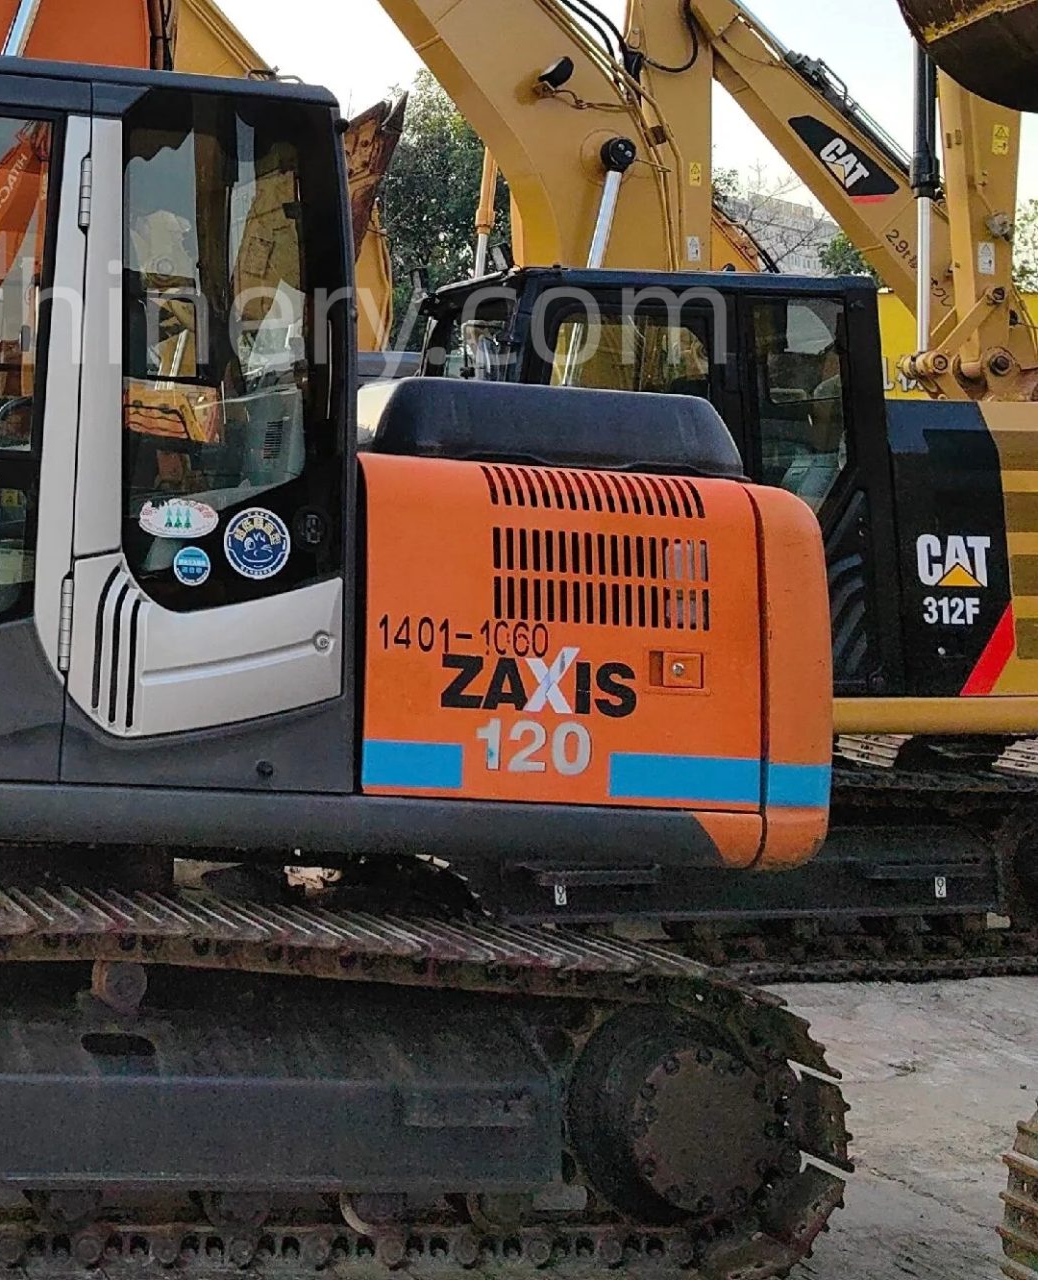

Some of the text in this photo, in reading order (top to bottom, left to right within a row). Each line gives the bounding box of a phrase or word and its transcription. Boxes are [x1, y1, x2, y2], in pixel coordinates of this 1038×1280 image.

[820, 137, 870, 189] CAT
[916, 533, 991, 588] CAT
[922, 596, 981, 625] 312F
[440, 646, 638, 718] ZAXIS
[476, 717, 593, 777] 120
